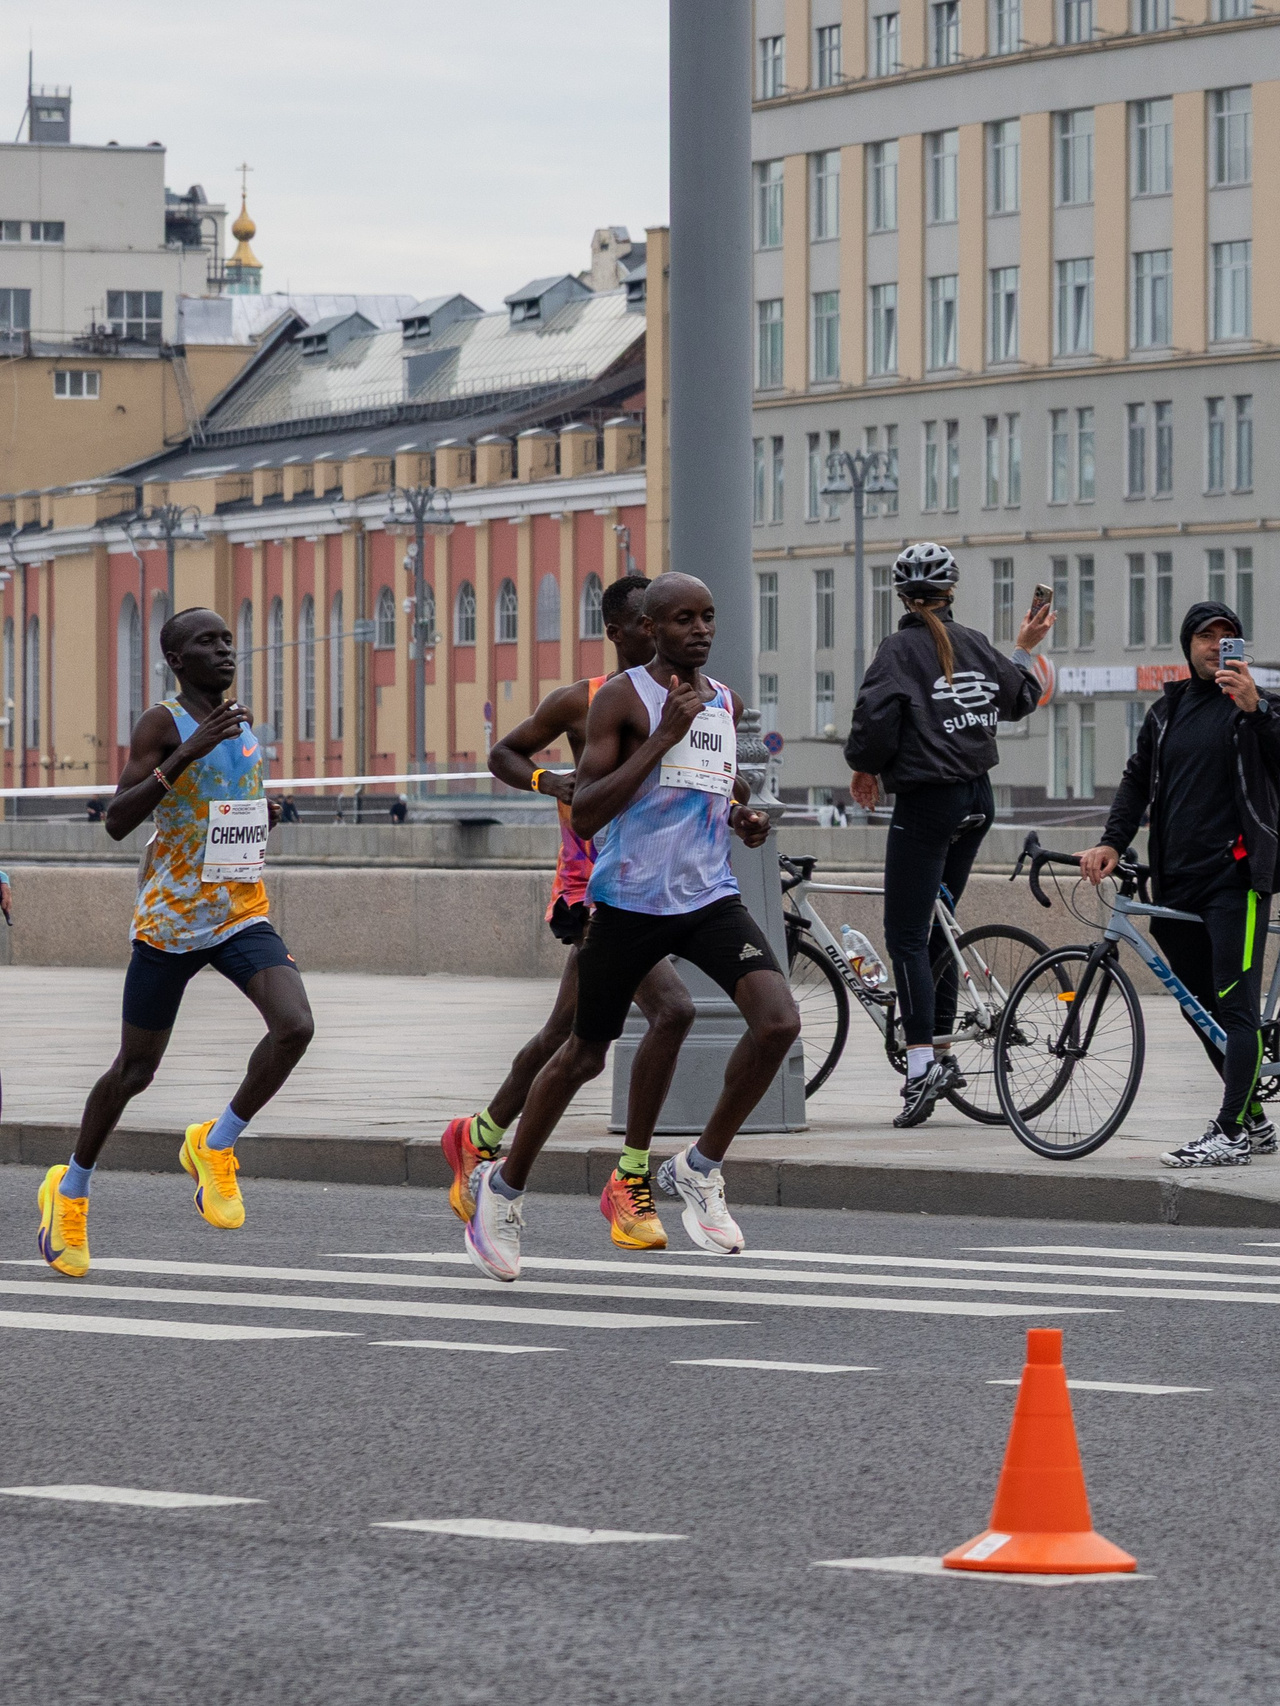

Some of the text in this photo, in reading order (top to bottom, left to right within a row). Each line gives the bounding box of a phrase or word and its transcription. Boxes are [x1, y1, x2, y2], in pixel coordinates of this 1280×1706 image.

[690, 729, 722, 752] KIRUI
[701, 759, 710, 767] 17
[242, 852, 248, 860] 4
